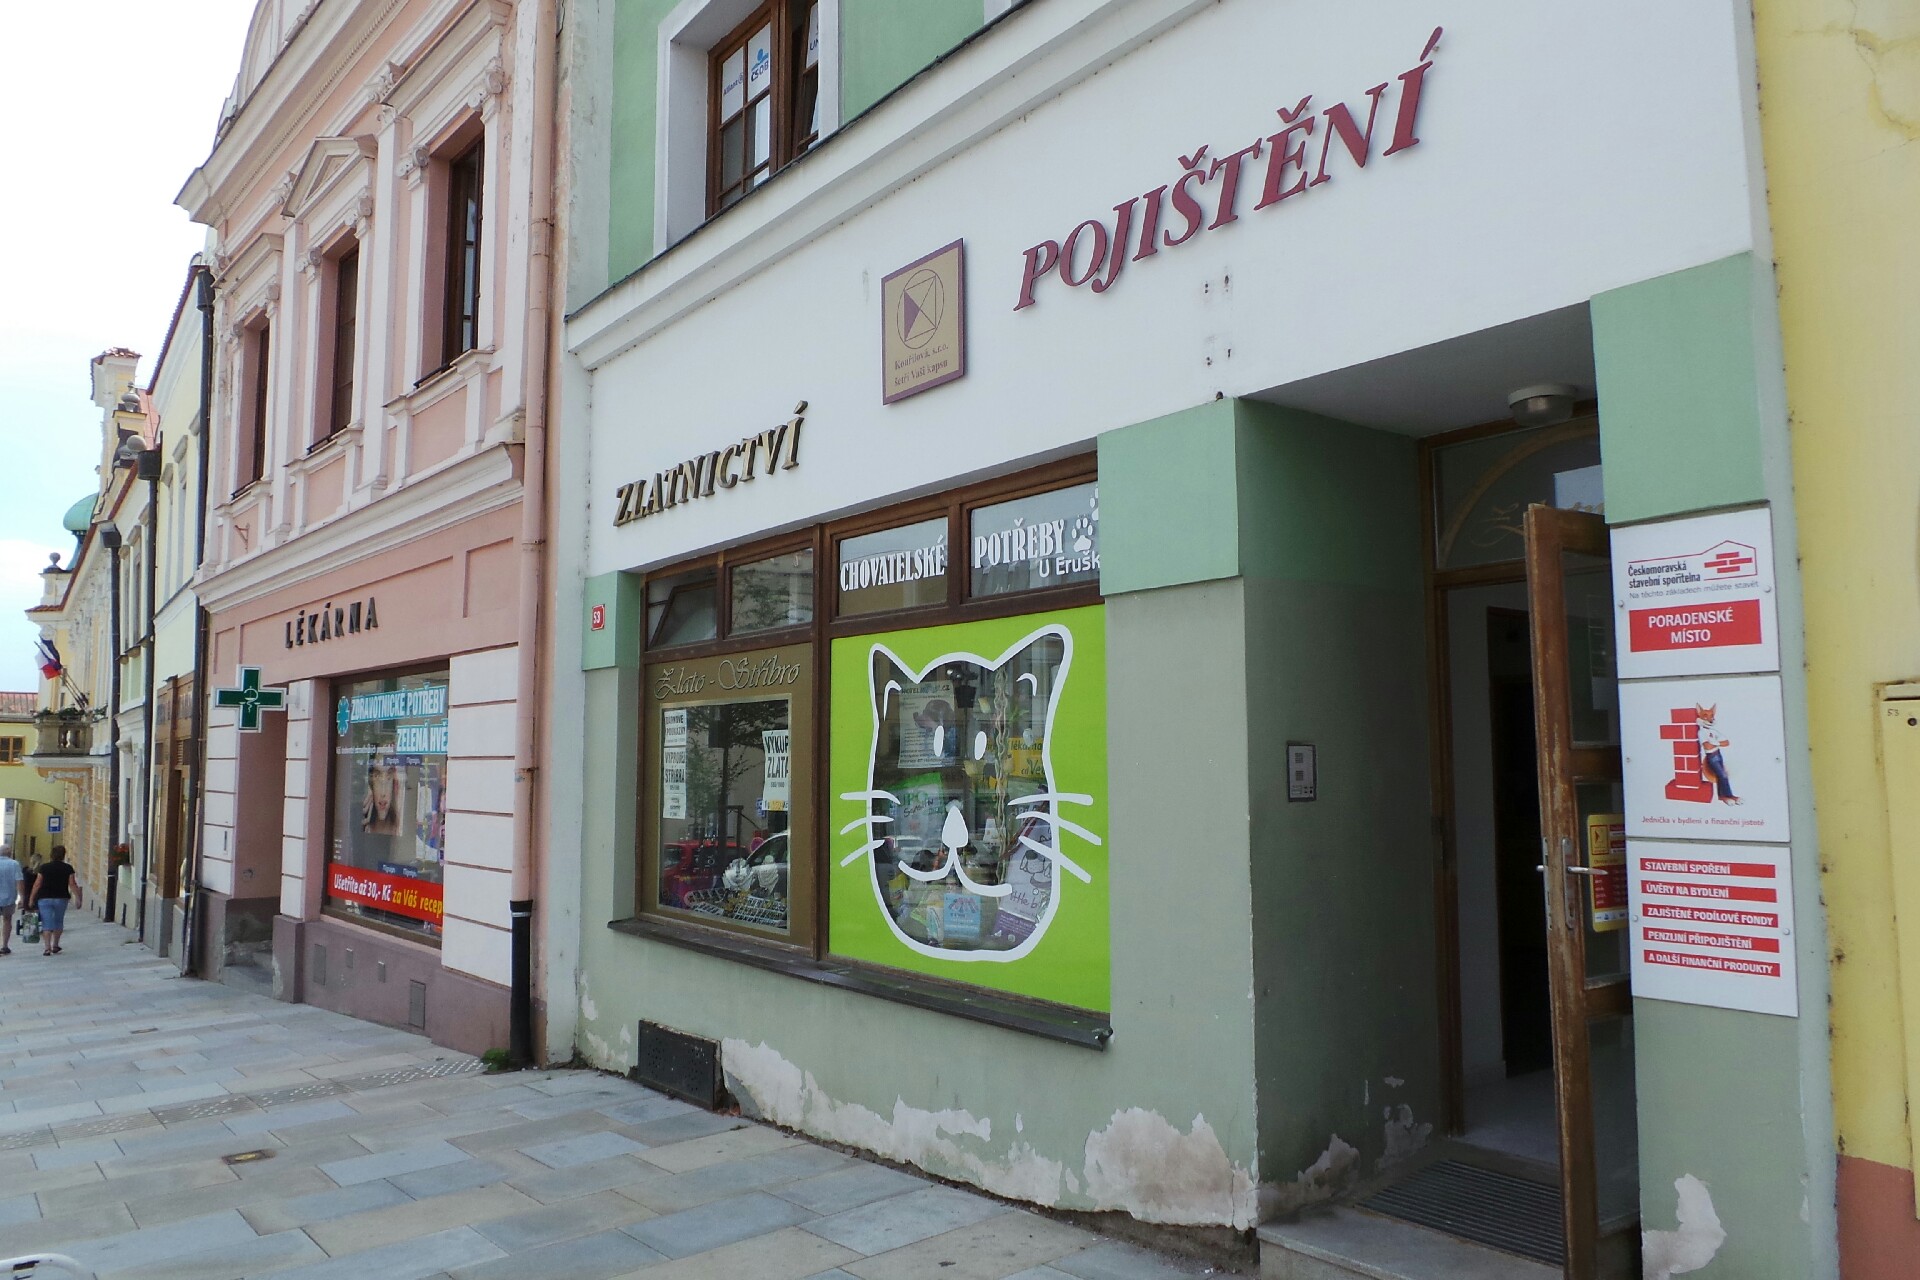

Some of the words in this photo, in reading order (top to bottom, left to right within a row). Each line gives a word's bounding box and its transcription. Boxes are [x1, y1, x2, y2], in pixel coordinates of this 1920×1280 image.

[1013, 26, 1443, 312] POJIŠTĚNÍ
[613, 400, 809, 527] ZLATNICTVÍ
[974, 518, 1065, 569] POTŘEBY
[840, 535, 945, 592] CHOVATELSKÉ
[1039, 559, 1050, 578] U
[1628, 561, 1687, 577] Českomoravská
[1628, 575, 1661, 589] stavební
[1662, 572, 1701, 587] spořitelna
[285, 597, 379, 649] LÉKÁRNA
[593, 610, 601, 624] 53
[1648, 606, 1734, 629] PORADENSKÉ
[1670, 628, 1711, 644] MÍSTO
[654, 667, 706, 700] Zlato
[718, 654, 801, 690] Stříbro
[350, 685, 406, 722] ZDRAVOTNICKÉ
[406, 683, 447, 717] POTŘEBY
[396, 719, 429, 753] ZELENÁ
[764, 731, 789, 754] VÝKUP
[1641, 815, 1671, 824] Jednička
[1711, 817, 1740, 826] finanční
[1644, 860, 1689, 873] STAVEBNÍ
[1690, 863, 1731, 875] SPOŘENÍ
[358, 879, 368, 896] až
[381, 884, 392, 902] Kč
[392, 890, 402, 904] za
[403, 888, 418, 909] Váš
[1646, 881, 1675, 894] ÚVĚRY
[1676, 886, 1689, 897] NA
[1690, 887, 1730, 898] BYDLENÍ
[1647, 906, 1692, 920] ZAJIŠTĚNÉ
[1693, 909, 1740, 923] PODÍLOVÉ
[1741, 915, 1774, 926] FONDY
[1648, 929, 1687, 943] PENZIJNÍ
[1688, 932, 1753, 949] PŘIPOJIŠTĚNÍ
[1649, 953, 1656, 961] A
[1656, 951, 1681, 964] DALŠÍ
[1682, 956, 1723, 969] FINANČNÍ
[1724, 962, 1773, 974] PRODUKTY
